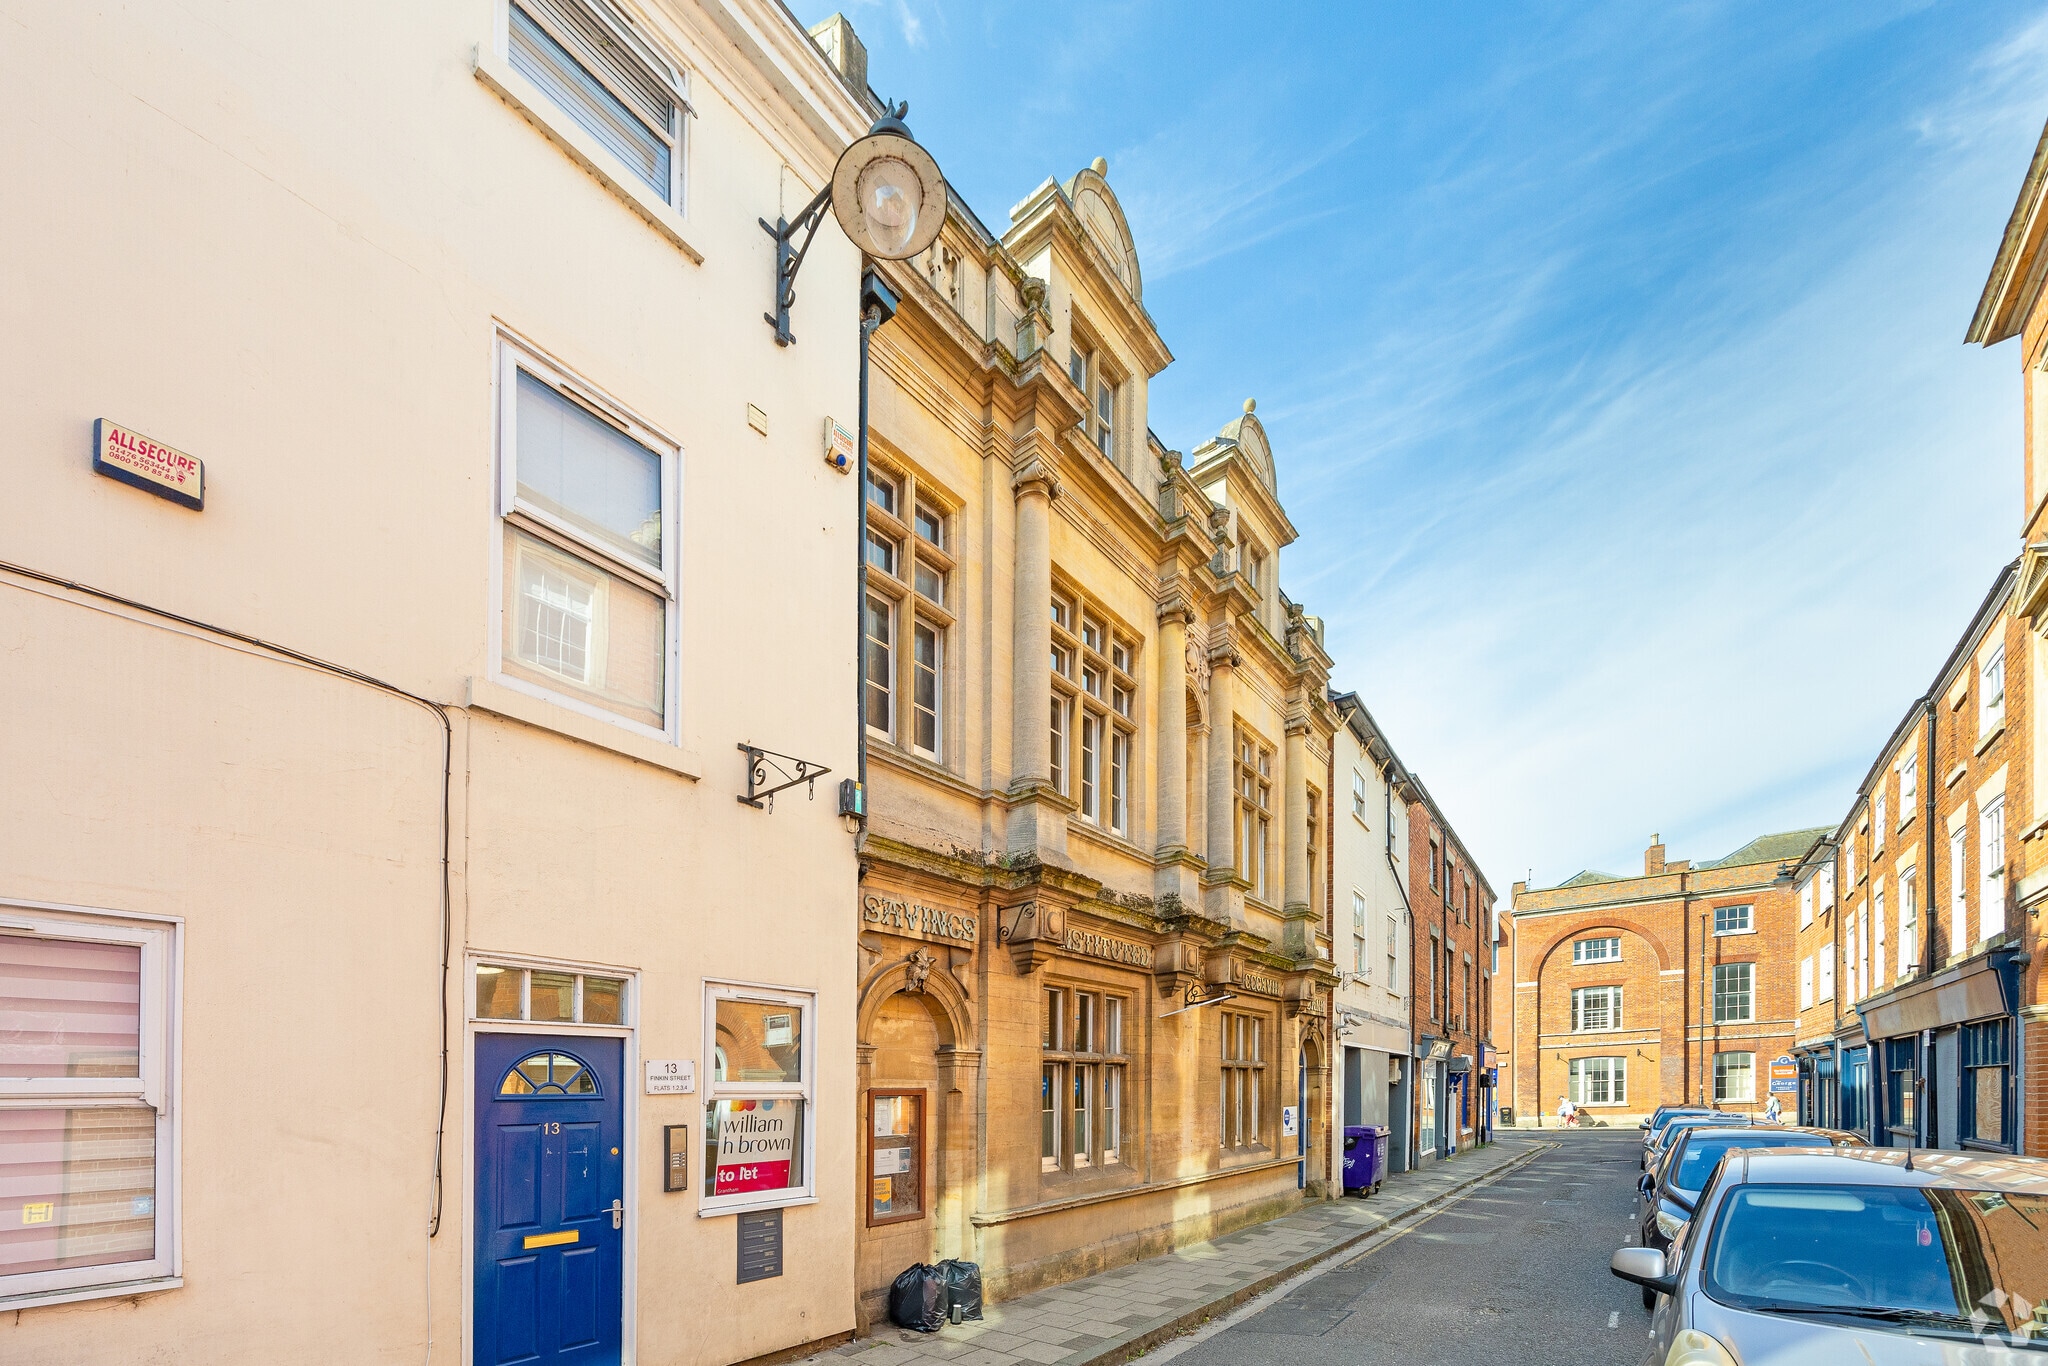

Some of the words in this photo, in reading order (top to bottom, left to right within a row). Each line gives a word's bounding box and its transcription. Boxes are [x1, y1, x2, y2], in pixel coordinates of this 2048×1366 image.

[108, 428, 197, 476] ALLSECURE
[109, 444, 137, 460] 01476
[108, 451, 131, 464] 0800
[133, 461, 150, 472] 970
[151, 468, 162, 477] 85
[164, 474, 175, 482] 85
[864, 893, 977, 942] SAVINGS
[664, 1063, 678, 1074] 13
[543, 1122, 560, 1135] 13
[724, 1114, 783, 1134] william
[723, 1136, 733, 1154] h
[738, 1135, 791, 1154] brown
[719, 1169, 735, 1183] to
[739, 1166, 759, 1180] let
